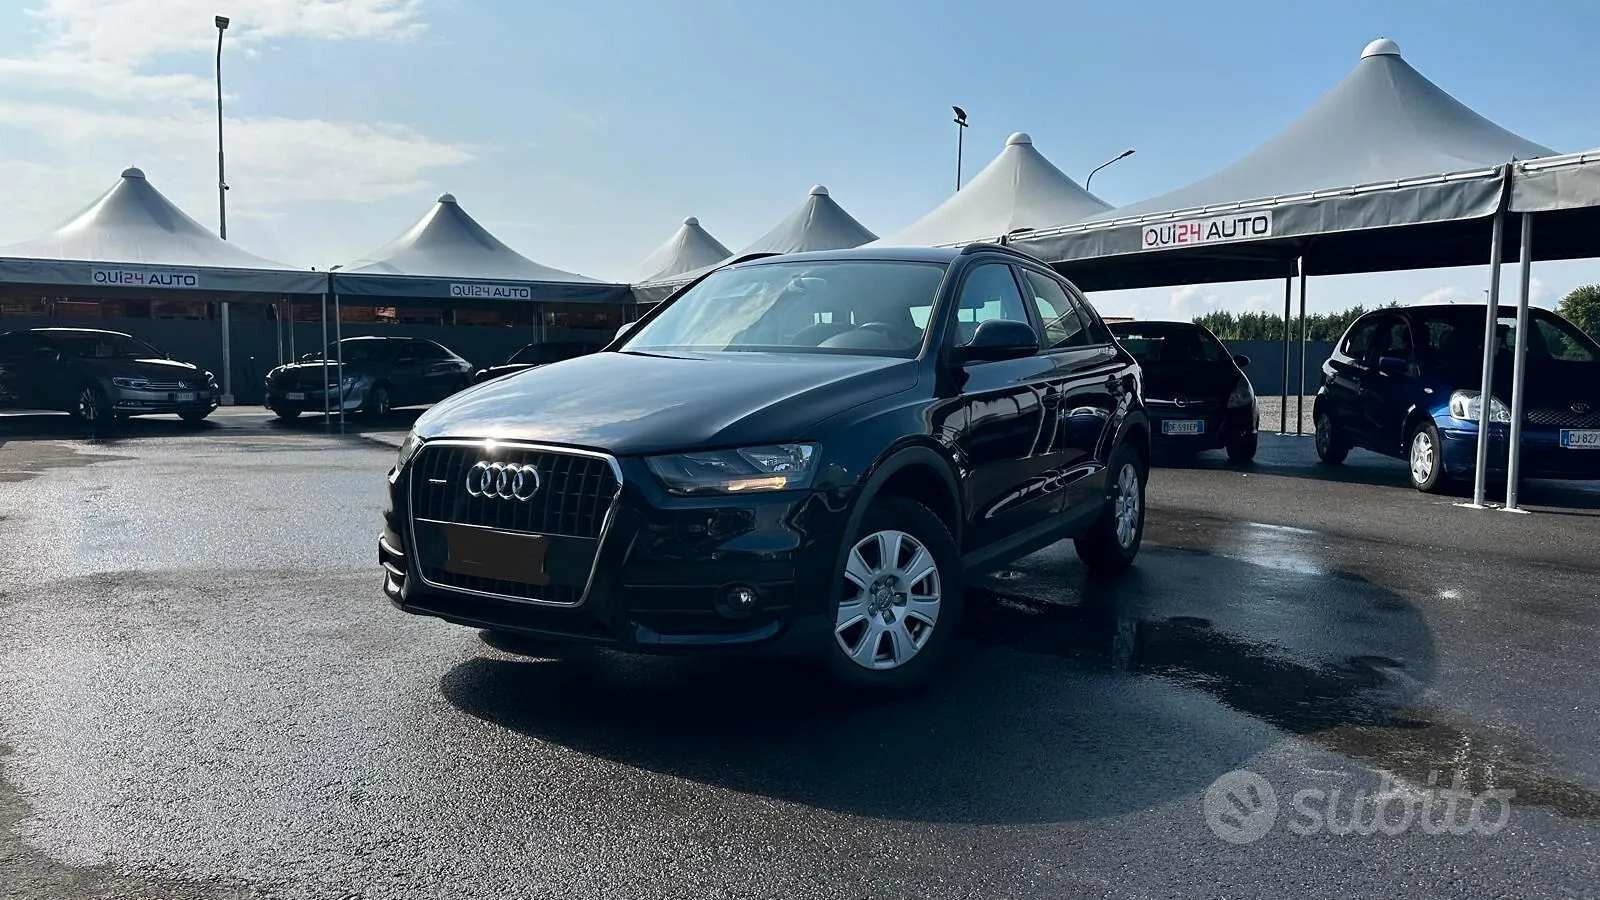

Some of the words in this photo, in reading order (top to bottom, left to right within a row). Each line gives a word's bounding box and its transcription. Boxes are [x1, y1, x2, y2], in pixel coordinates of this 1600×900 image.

[1206, 216, 1268, 240] AUTO
[148, 274, 196, 286] AUTO
[493, 287, 529, 298] AUTO
[1569, 433, 1580, 443] CJ
